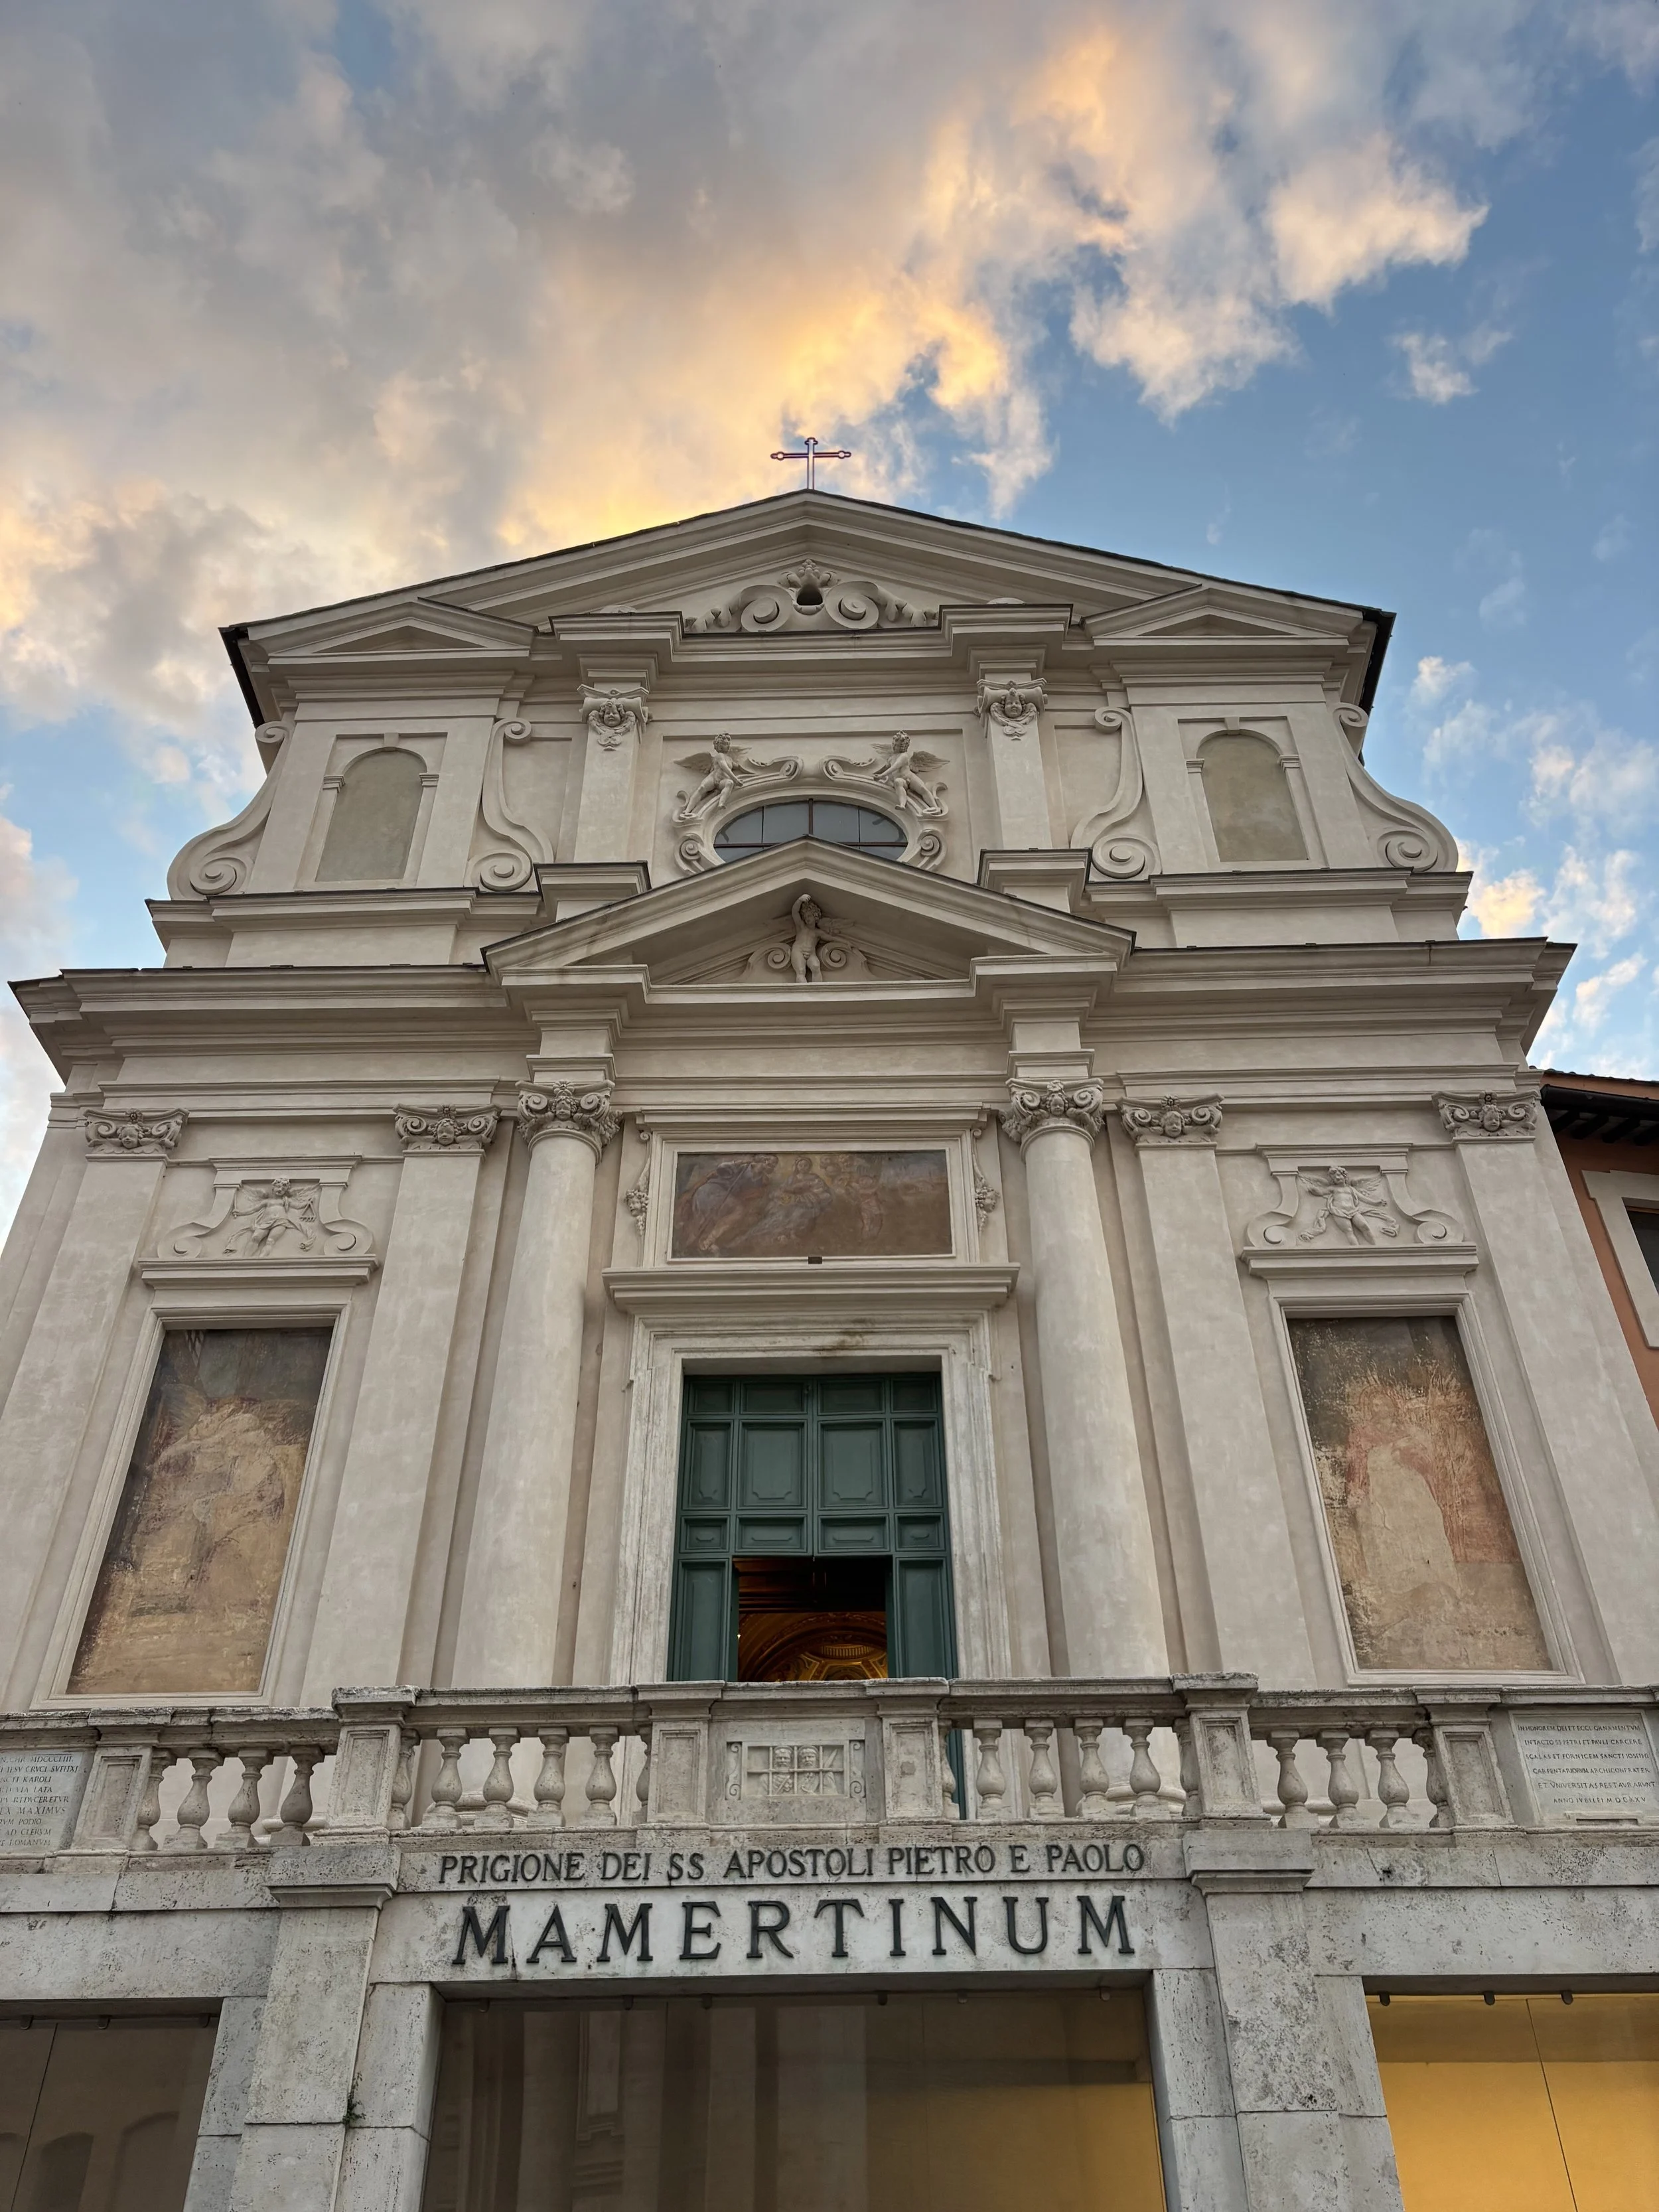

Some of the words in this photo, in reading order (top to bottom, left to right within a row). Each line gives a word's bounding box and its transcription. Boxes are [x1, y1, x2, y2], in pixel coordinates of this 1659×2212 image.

[439, 1854, 585, 1883] PRIGIONE
[601, 1852, 652, 1880] DEI
[668, 1852, 704, 1880] SS
[723, 1848, 873, 1878] APOSTOLI
[887, 1845, 995, 1875] PIETRO
[1009, 1845, 1031, 1872] E
[1046, 1844, 1144, 1872] PAOLO
[452, 1895, 1135, 1964] MAMERTINUM
